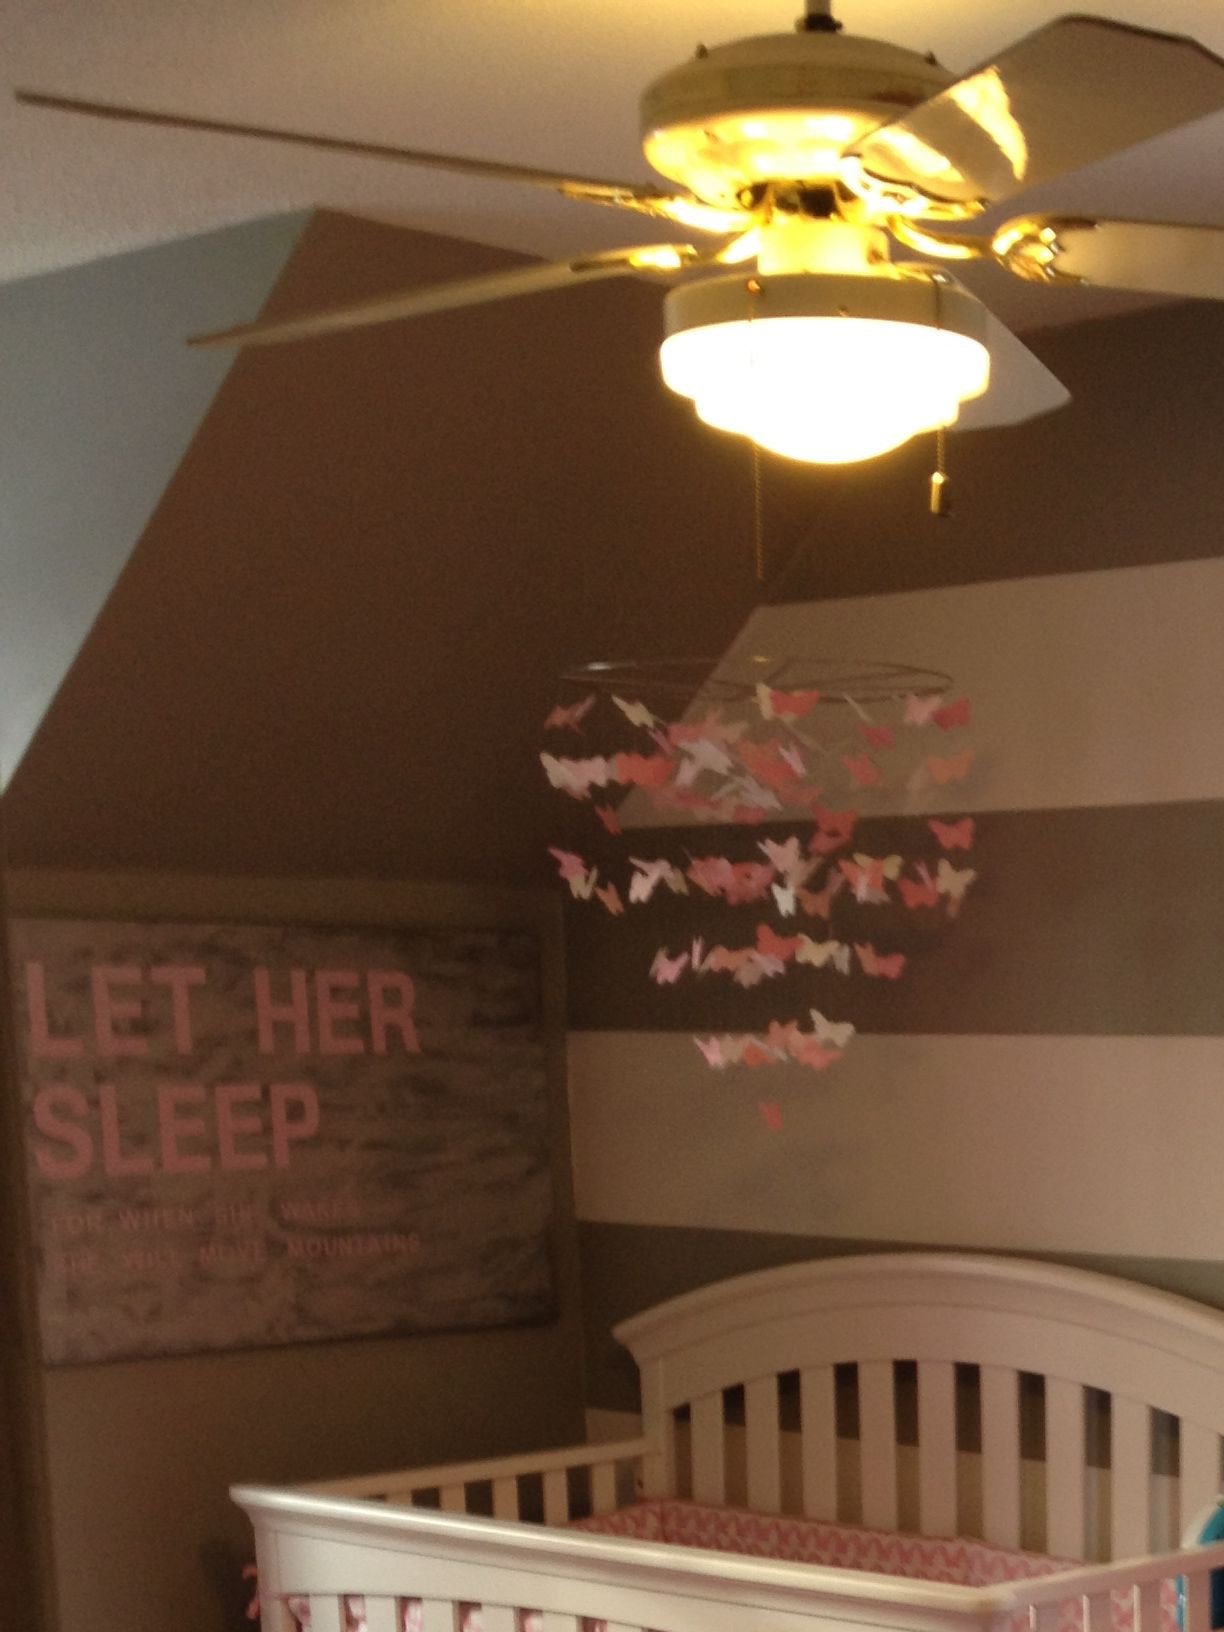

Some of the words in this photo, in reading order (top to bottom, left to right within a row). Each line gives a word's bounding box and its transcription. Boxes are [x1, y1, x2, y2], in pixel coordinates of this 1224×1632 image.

[24, 961, 207, 1060] LET
[253, 967, 422, 1057] HER
[33, 1082, 321, 1180] SLEEP
[286, 1233, 420, 1257] MOUNTAINS
